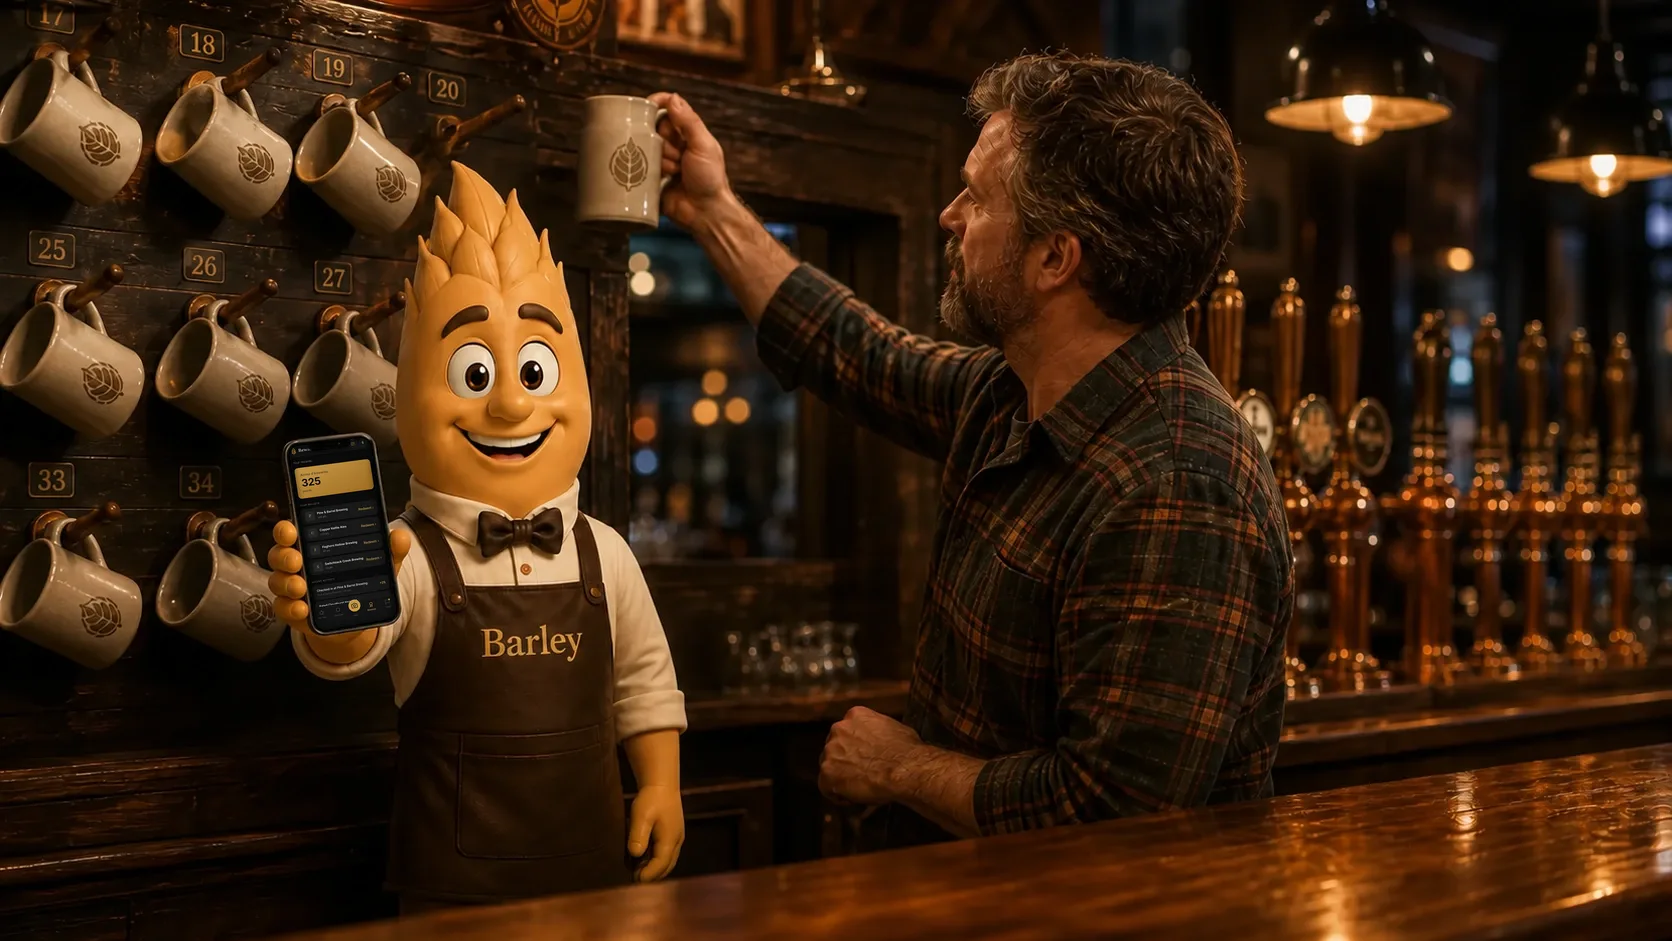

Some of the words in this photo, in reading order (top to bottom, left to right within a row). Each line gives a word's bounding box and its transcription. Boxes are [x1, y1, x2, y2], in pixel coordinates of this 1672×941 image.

[40, 1, 63, 26] 17
[191, 32, 215, 55] 18
[323, 57, 345, 78] 19
[436, 79, 459, 100] 20
[38, 238, 66, 261] 25
[191, 255, 216, 277] 26
[323, 268, 346, 288] 27
[38, 469, 66, 491] 33
[188, 472, 214, 493] 34
[301, 476, 321, 487] 325
[480, 624, 583, 662] Barley
